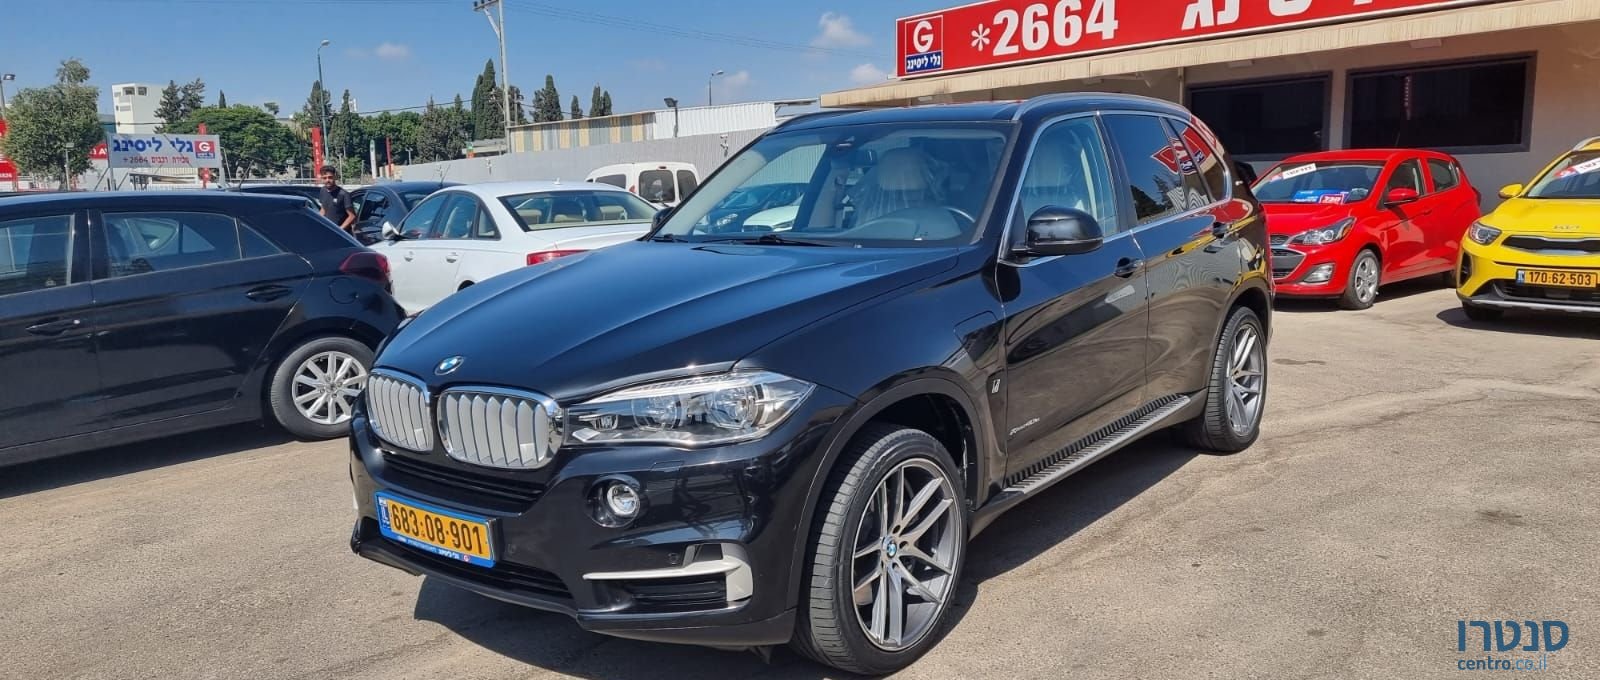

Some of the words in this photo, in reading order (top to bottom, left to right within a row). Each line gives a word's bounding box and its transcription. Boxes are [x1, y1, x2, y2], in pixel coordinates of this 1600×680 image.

[913, 20, 934, 53] G
[113, 137, 162, 153] ליסינג
[171, 138, 194, 153] גלי
[198, 142, 211, 152] G
